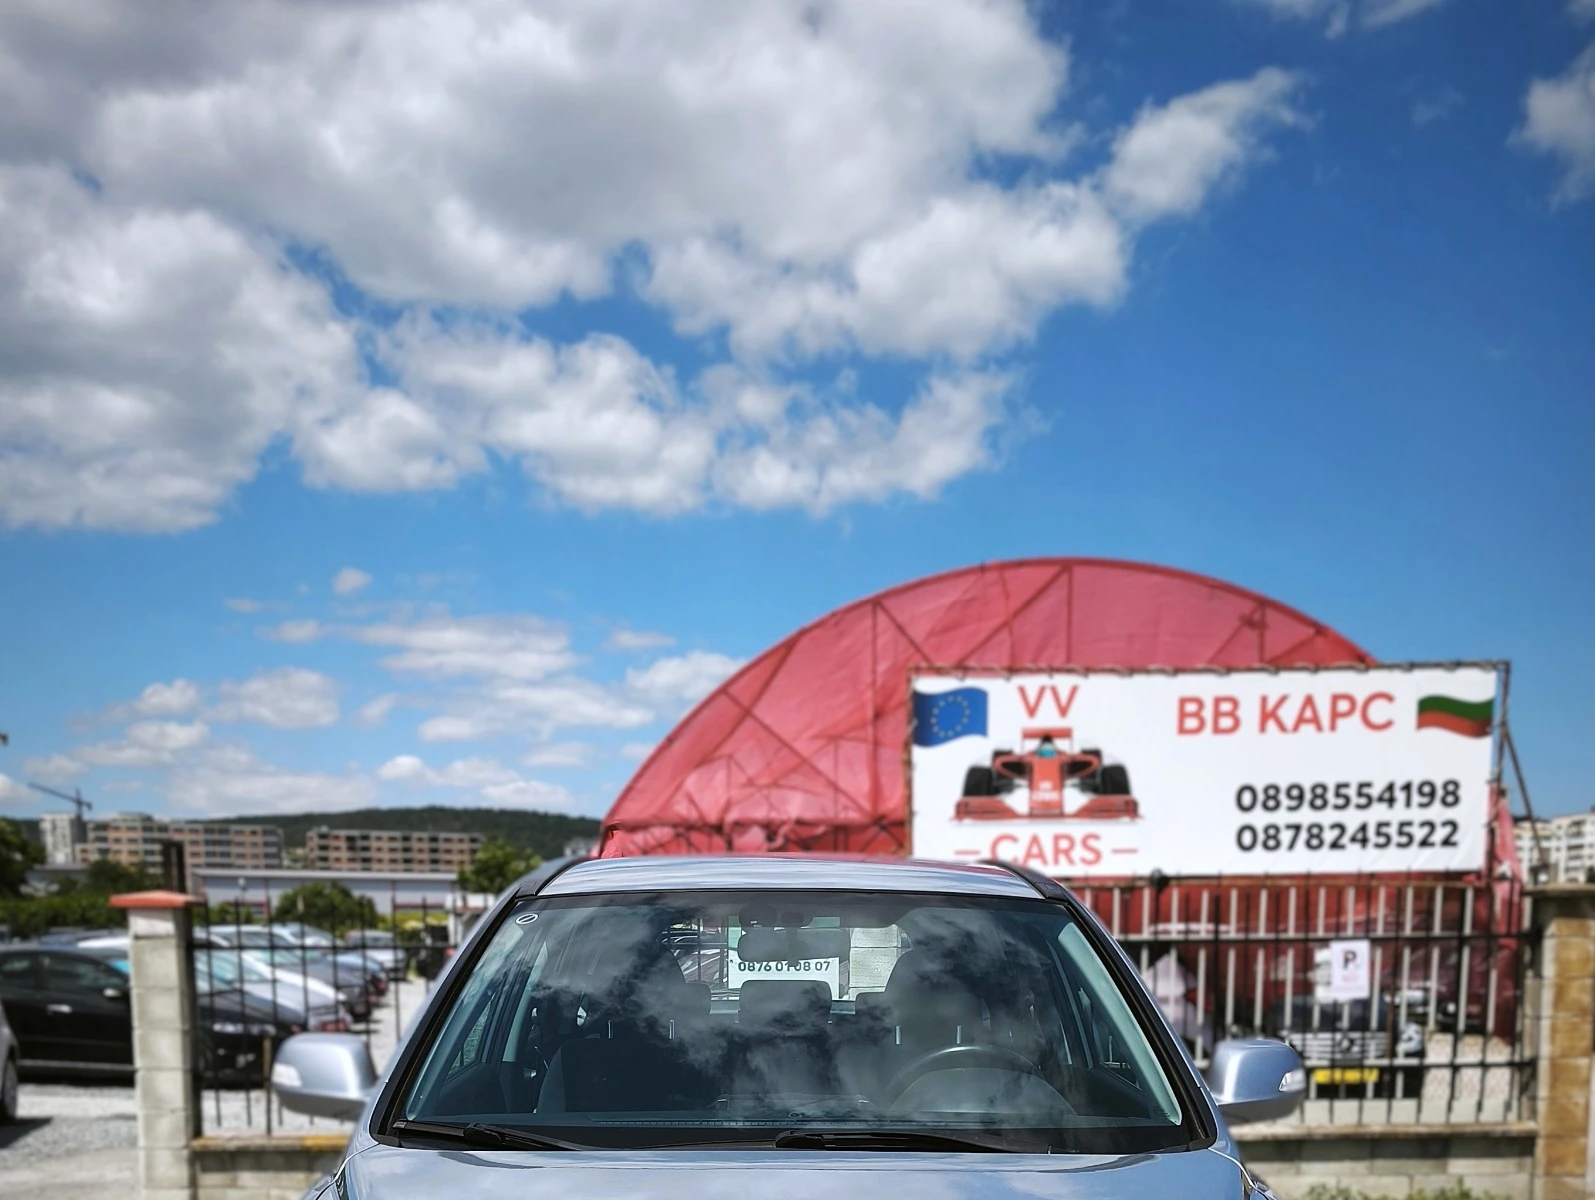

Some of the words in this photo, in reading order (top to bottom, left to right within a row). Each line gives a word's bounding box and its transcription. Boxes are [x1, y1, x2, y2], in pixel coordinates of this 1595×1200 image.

[1017, 685, 1079, 719] VV
[1258, 691, 1396, 734] КАРС
[1235, 779, 1462, 814] 0898554198
[989, 832, 1103, 867] CARS
[1235, 819, 1461, 852] 0878245522
[738, 961, 772, 972] 0876
[815, 961, 830, 972] 07
